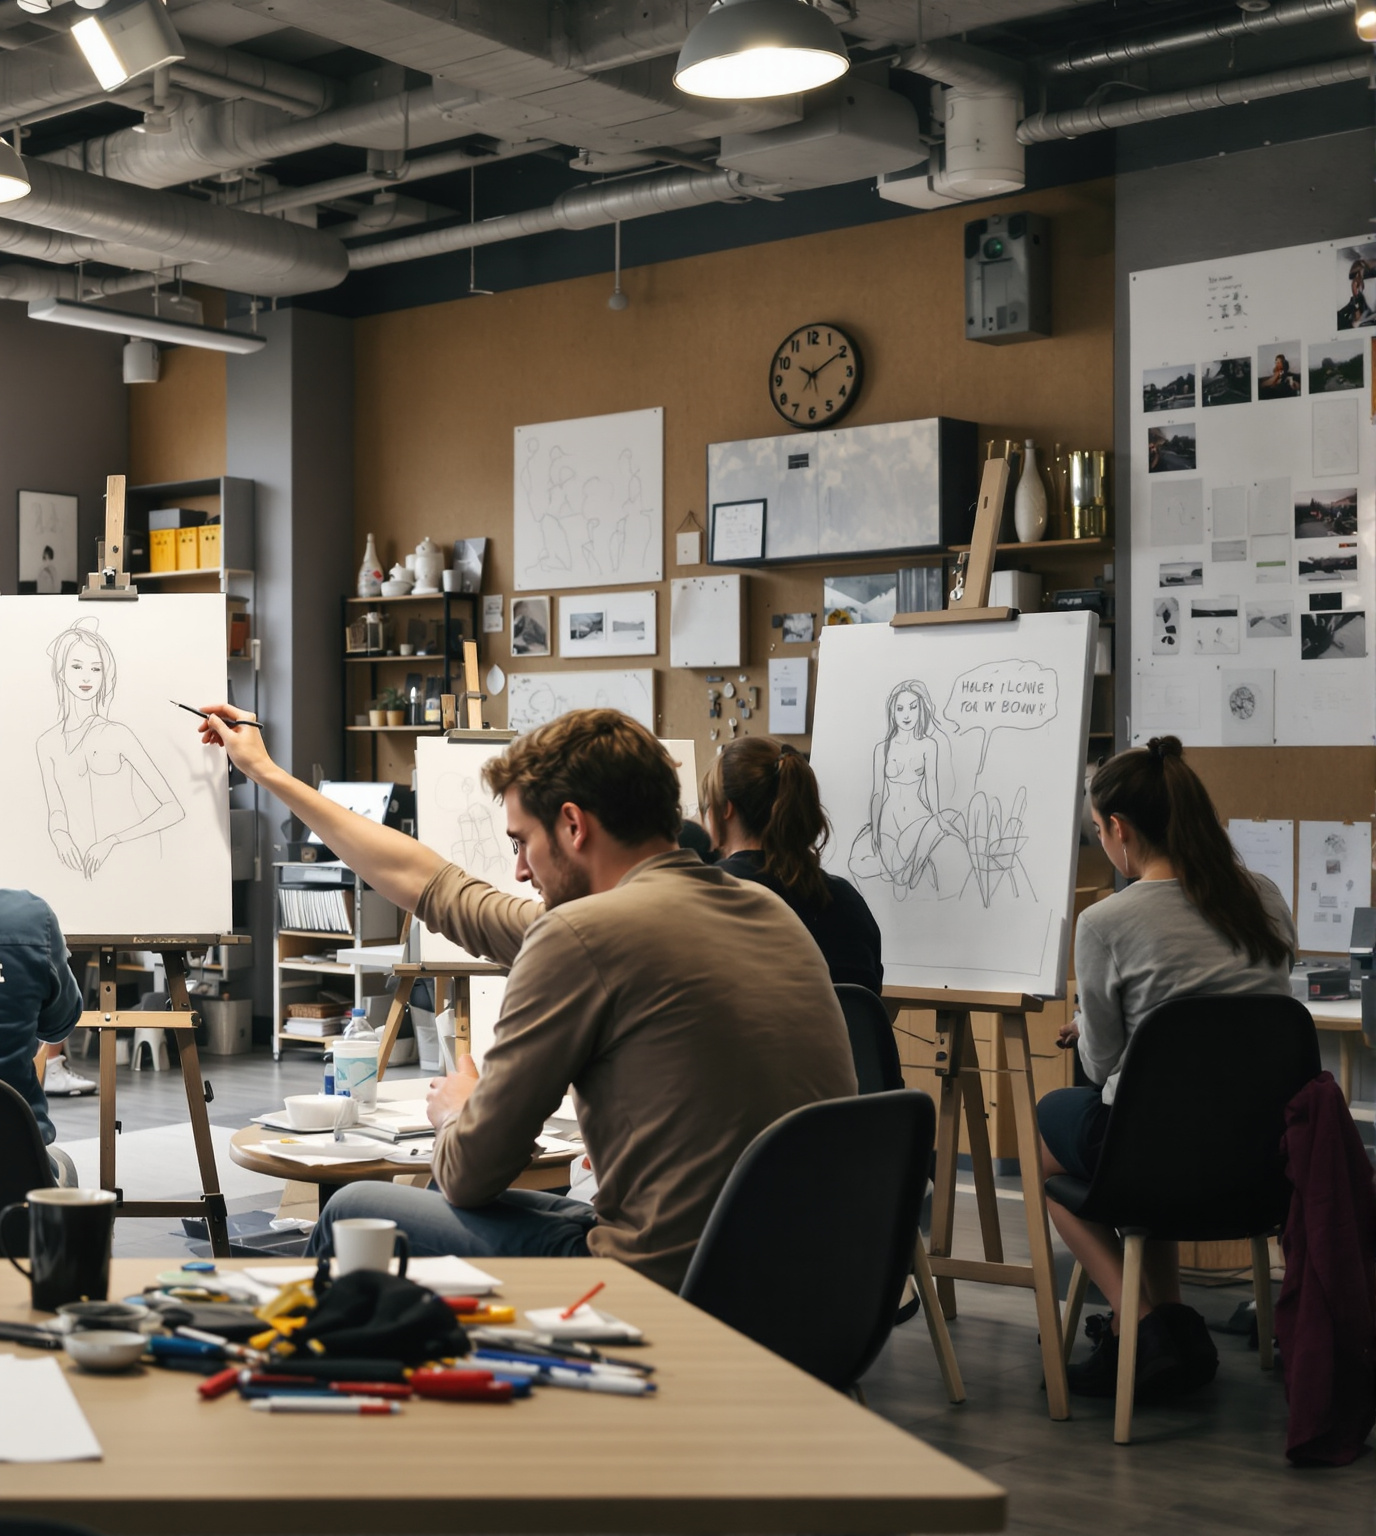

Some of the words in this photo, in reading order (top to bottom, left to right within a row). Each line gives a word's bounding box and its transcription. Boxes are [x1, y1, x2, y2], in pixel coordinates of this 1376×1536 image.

[807, 330, 820, 345] 12
[827, 332, 832, 346] 1
[791, 339, 800, 353] 11
[838, 345, 847, 358] 2
[779, 356, 791, 370] 10
[846, 365, 853, 378] 3
[775, 375, 783, 387] 9
[838, 384, 846, 398] 4
[780, 392, 788, 406] 8
[791, 403, 800, 416] 7
[808, 406, 817, 419] 6
[825, 400, 833, 412] 5
